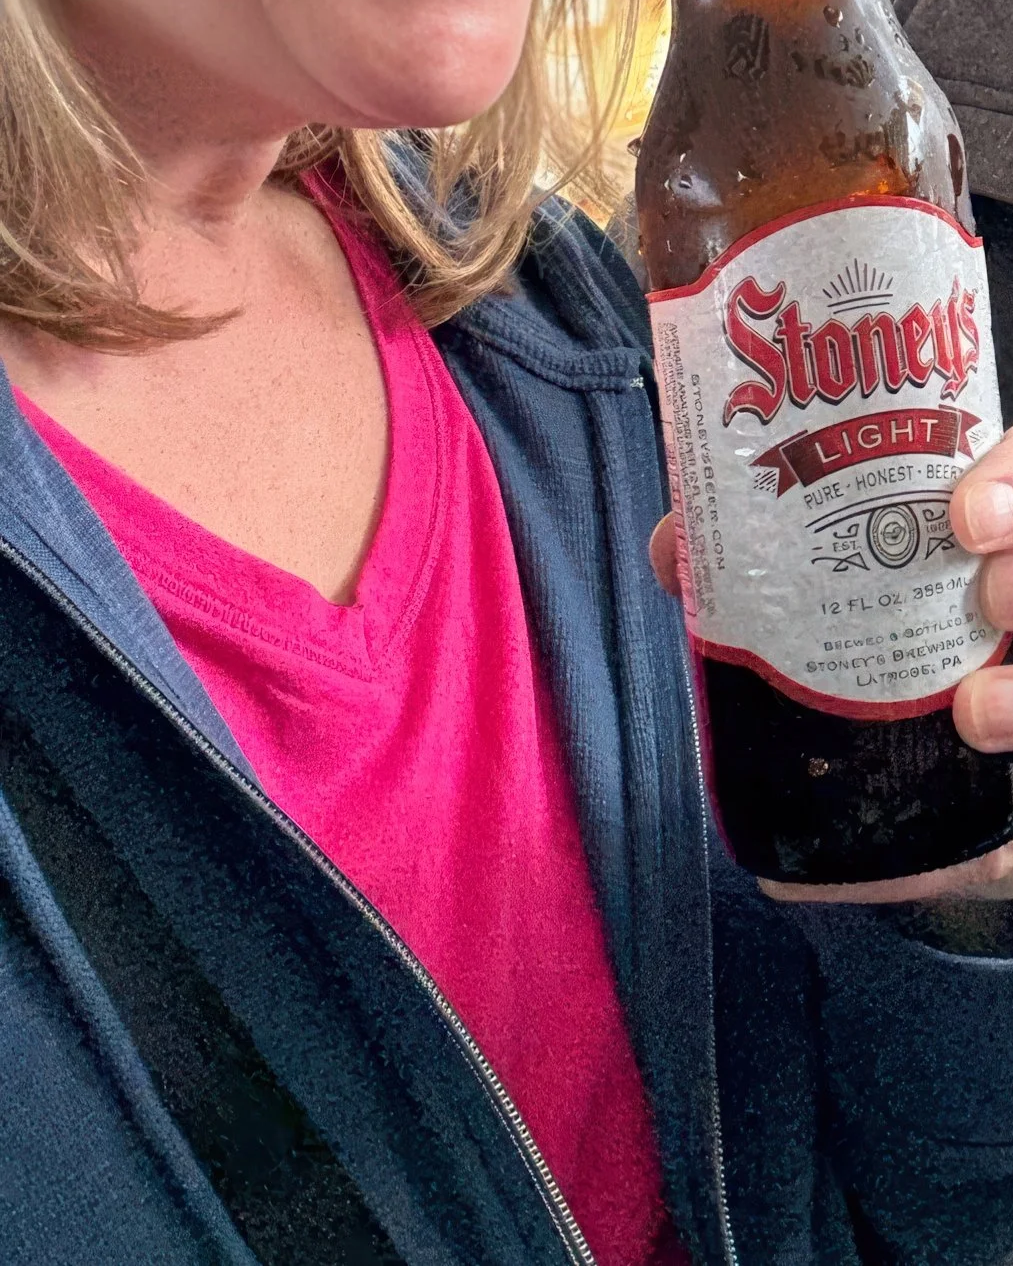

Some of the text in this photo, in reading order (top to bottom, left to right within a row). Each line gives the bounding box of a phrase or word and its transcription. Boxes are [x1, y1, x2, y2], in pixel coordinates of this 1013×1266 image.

[814, 418, 939, 464] LIGHT
[804, 483, 844, 510] PURE
[856, 465, 914, 491] HONEST
[821, 602, 842, 616] 12
[847, 598, 873, 612] FL
[942, 655, 963, 671] PA
